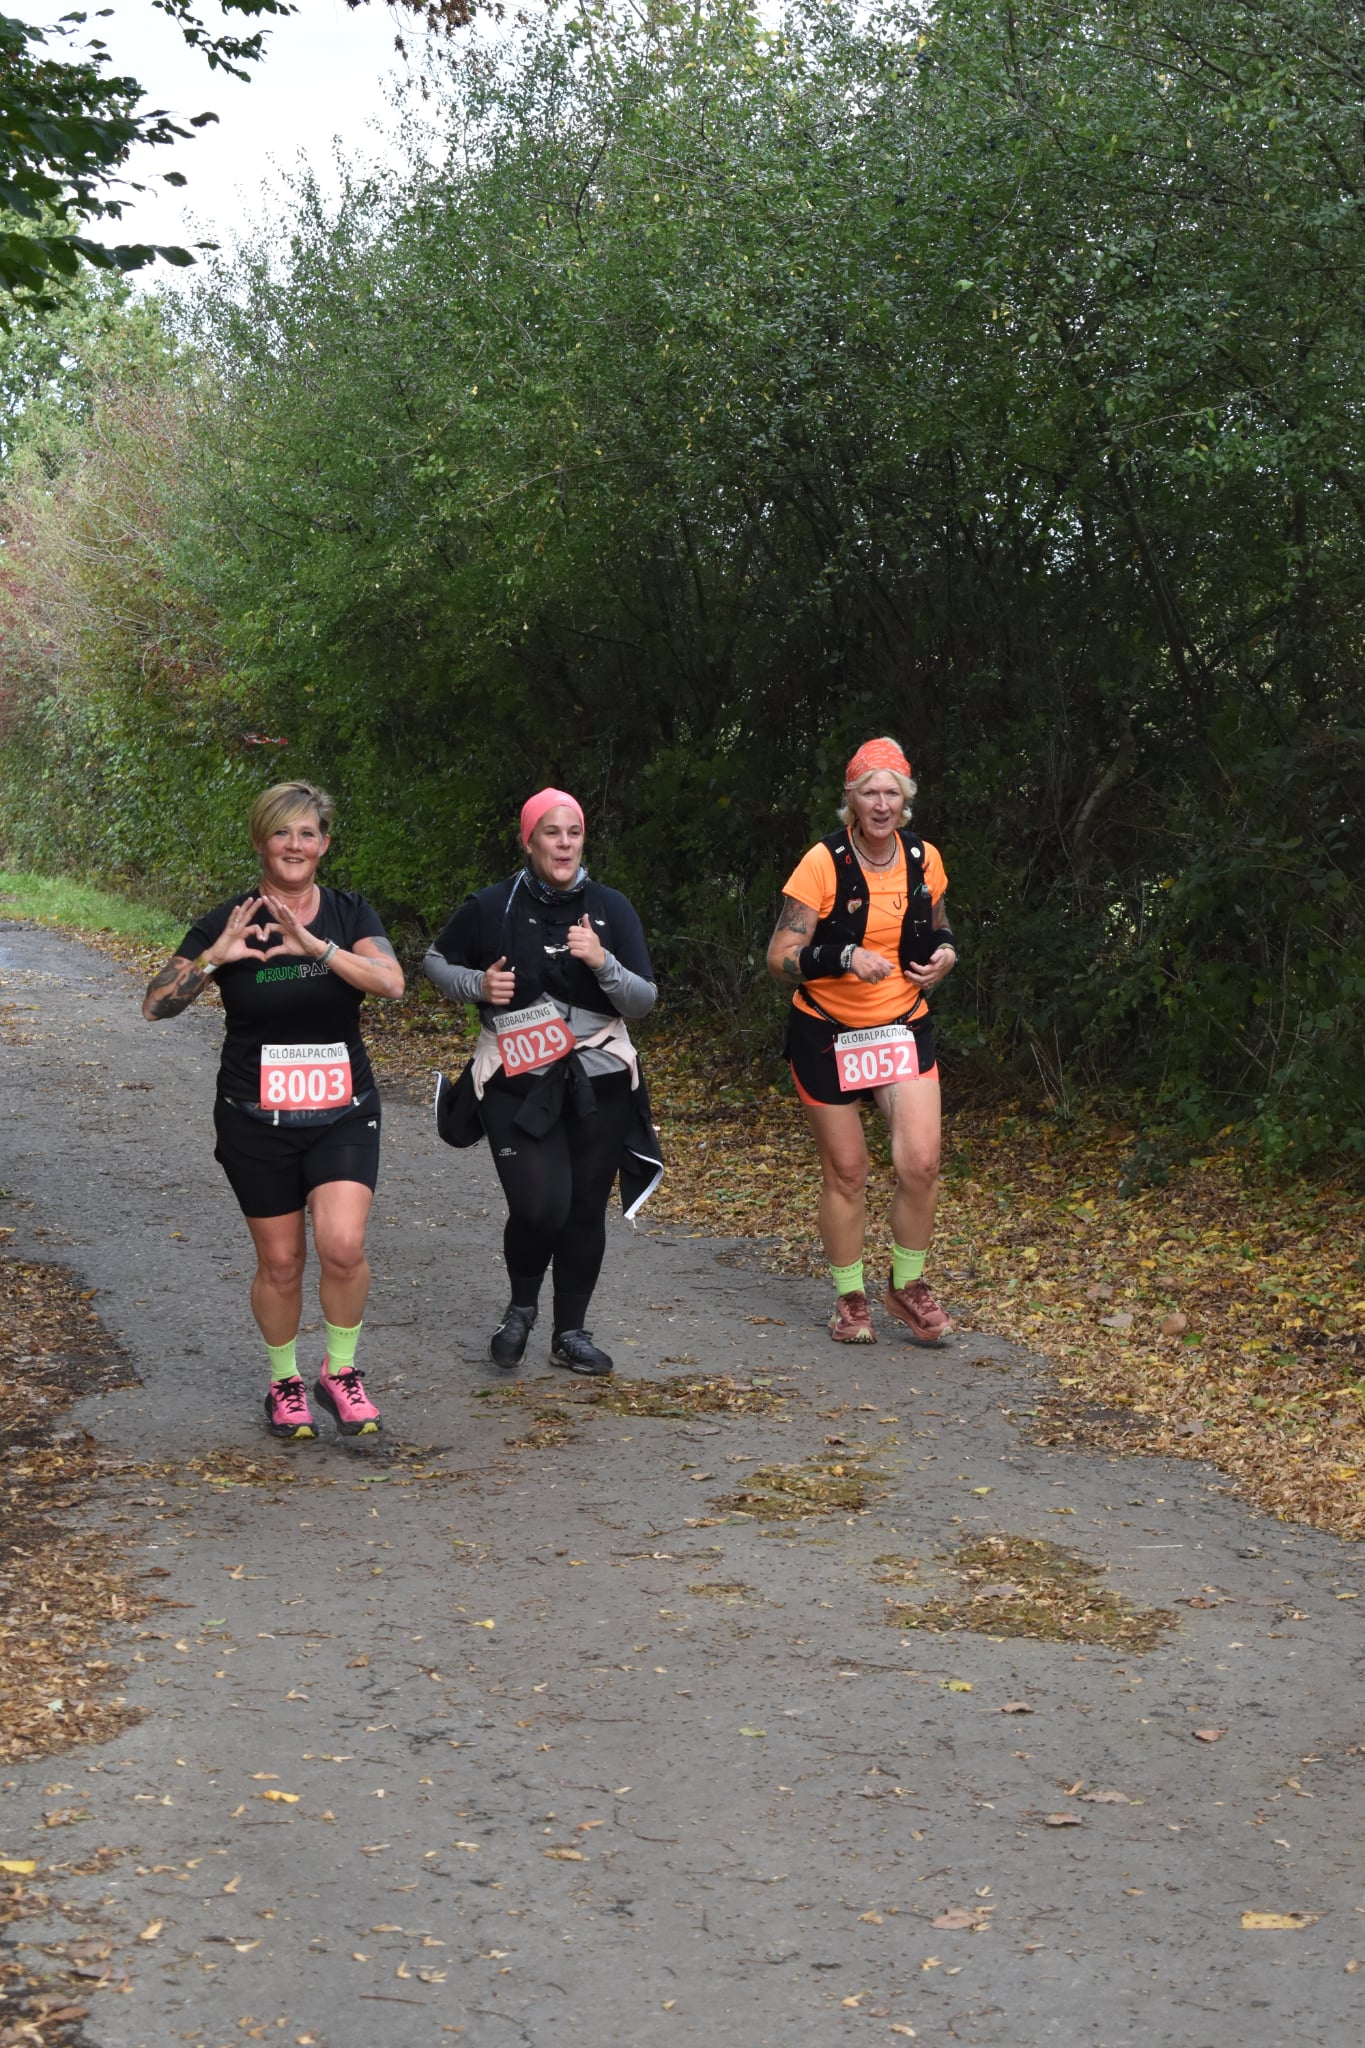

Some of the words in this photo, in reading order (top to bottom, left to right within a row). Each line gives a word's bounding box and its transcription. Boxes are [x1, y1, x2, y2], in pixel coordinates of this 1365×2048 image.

[498, 1006, 551, 1028] GLOBALPACING
[502, 1025, 567, 1068] 8029
[840, 1027, 908, 1045] GLOBALPACING
[269, 1046, 343, 1059] GLOBALPACING
[843, 1045, 912, 1083] 8052
[267, 1068, 346, 1103] 8003
